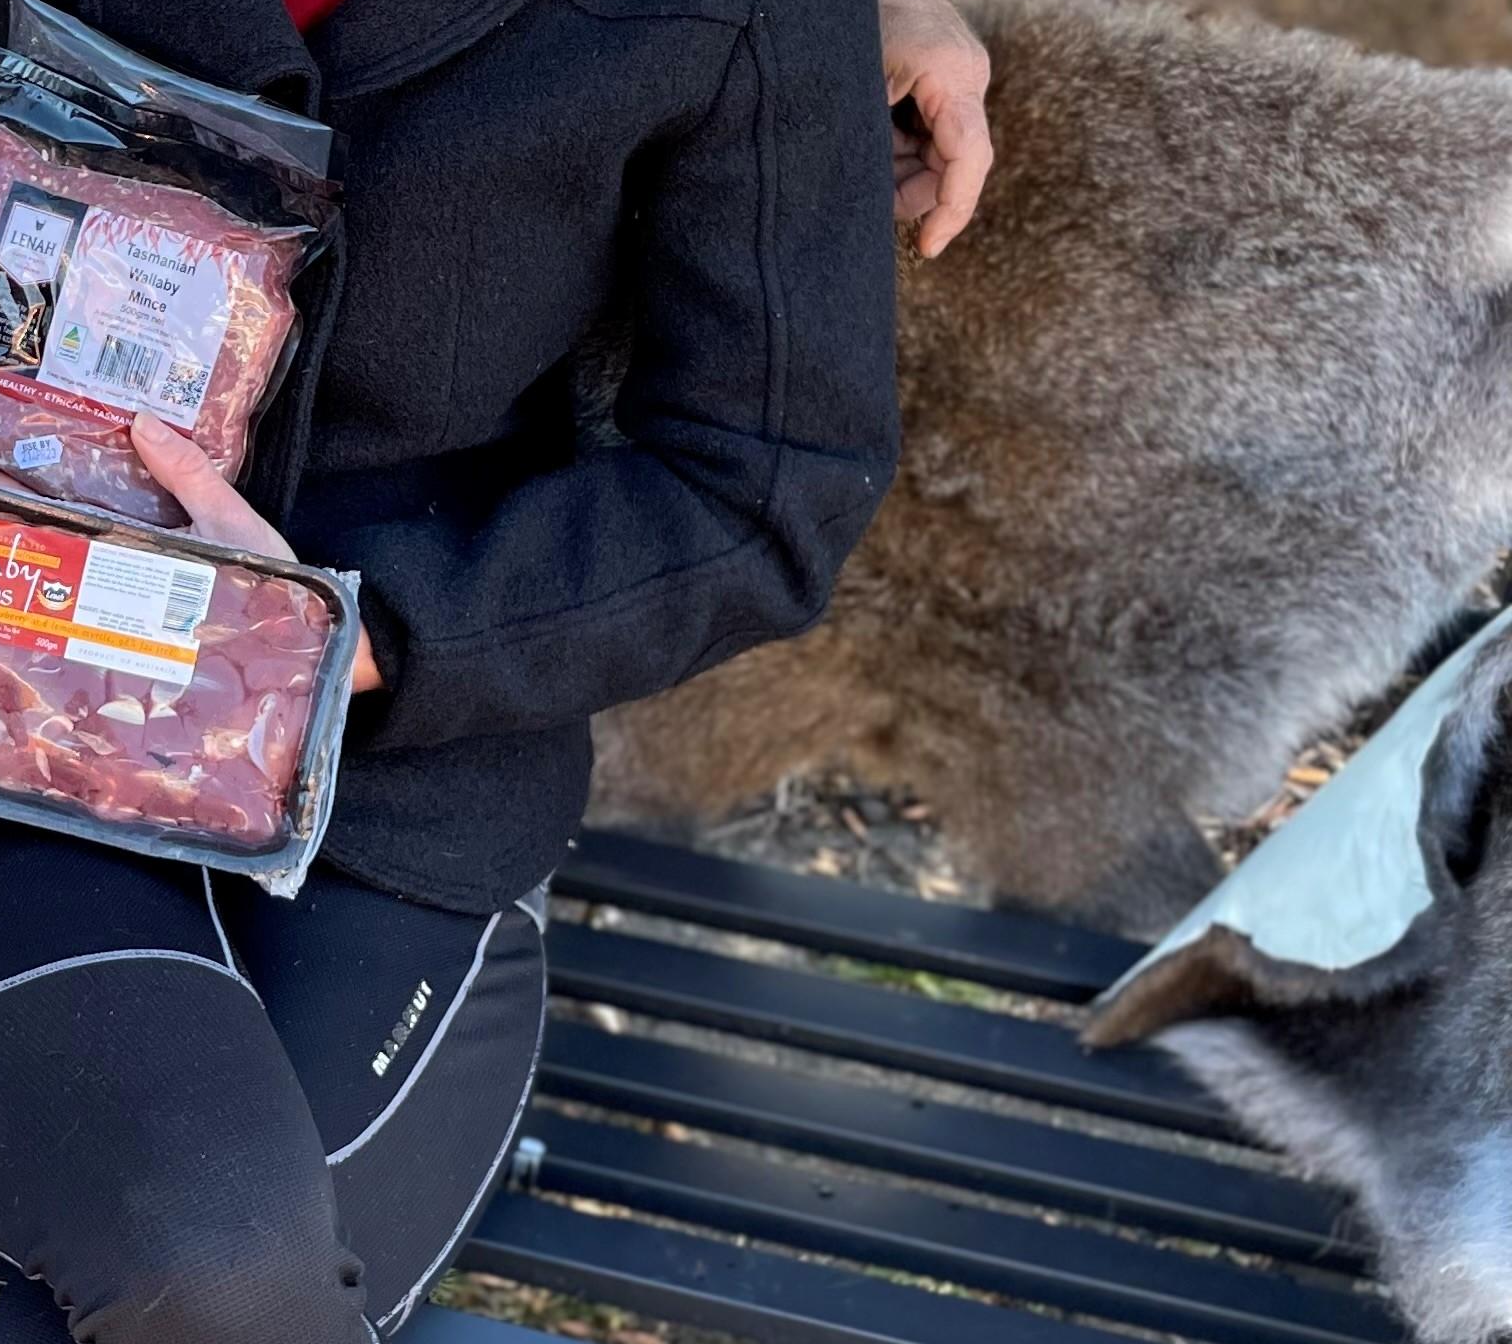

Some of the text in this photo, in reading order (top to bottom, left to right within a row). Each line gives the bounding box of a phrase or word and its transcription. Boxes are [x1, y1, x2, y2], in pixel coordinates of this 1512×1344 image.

[10, 230, 57, 256] LENAH
[127, 242, 196, 276] Tasmanian
[129, 266, 181, 296] Wallaby
[128, 289, 167, 313] Mince
[44, 392, 84, 413] ETHICAL
[92, 408, 134, 427] TASMAN
